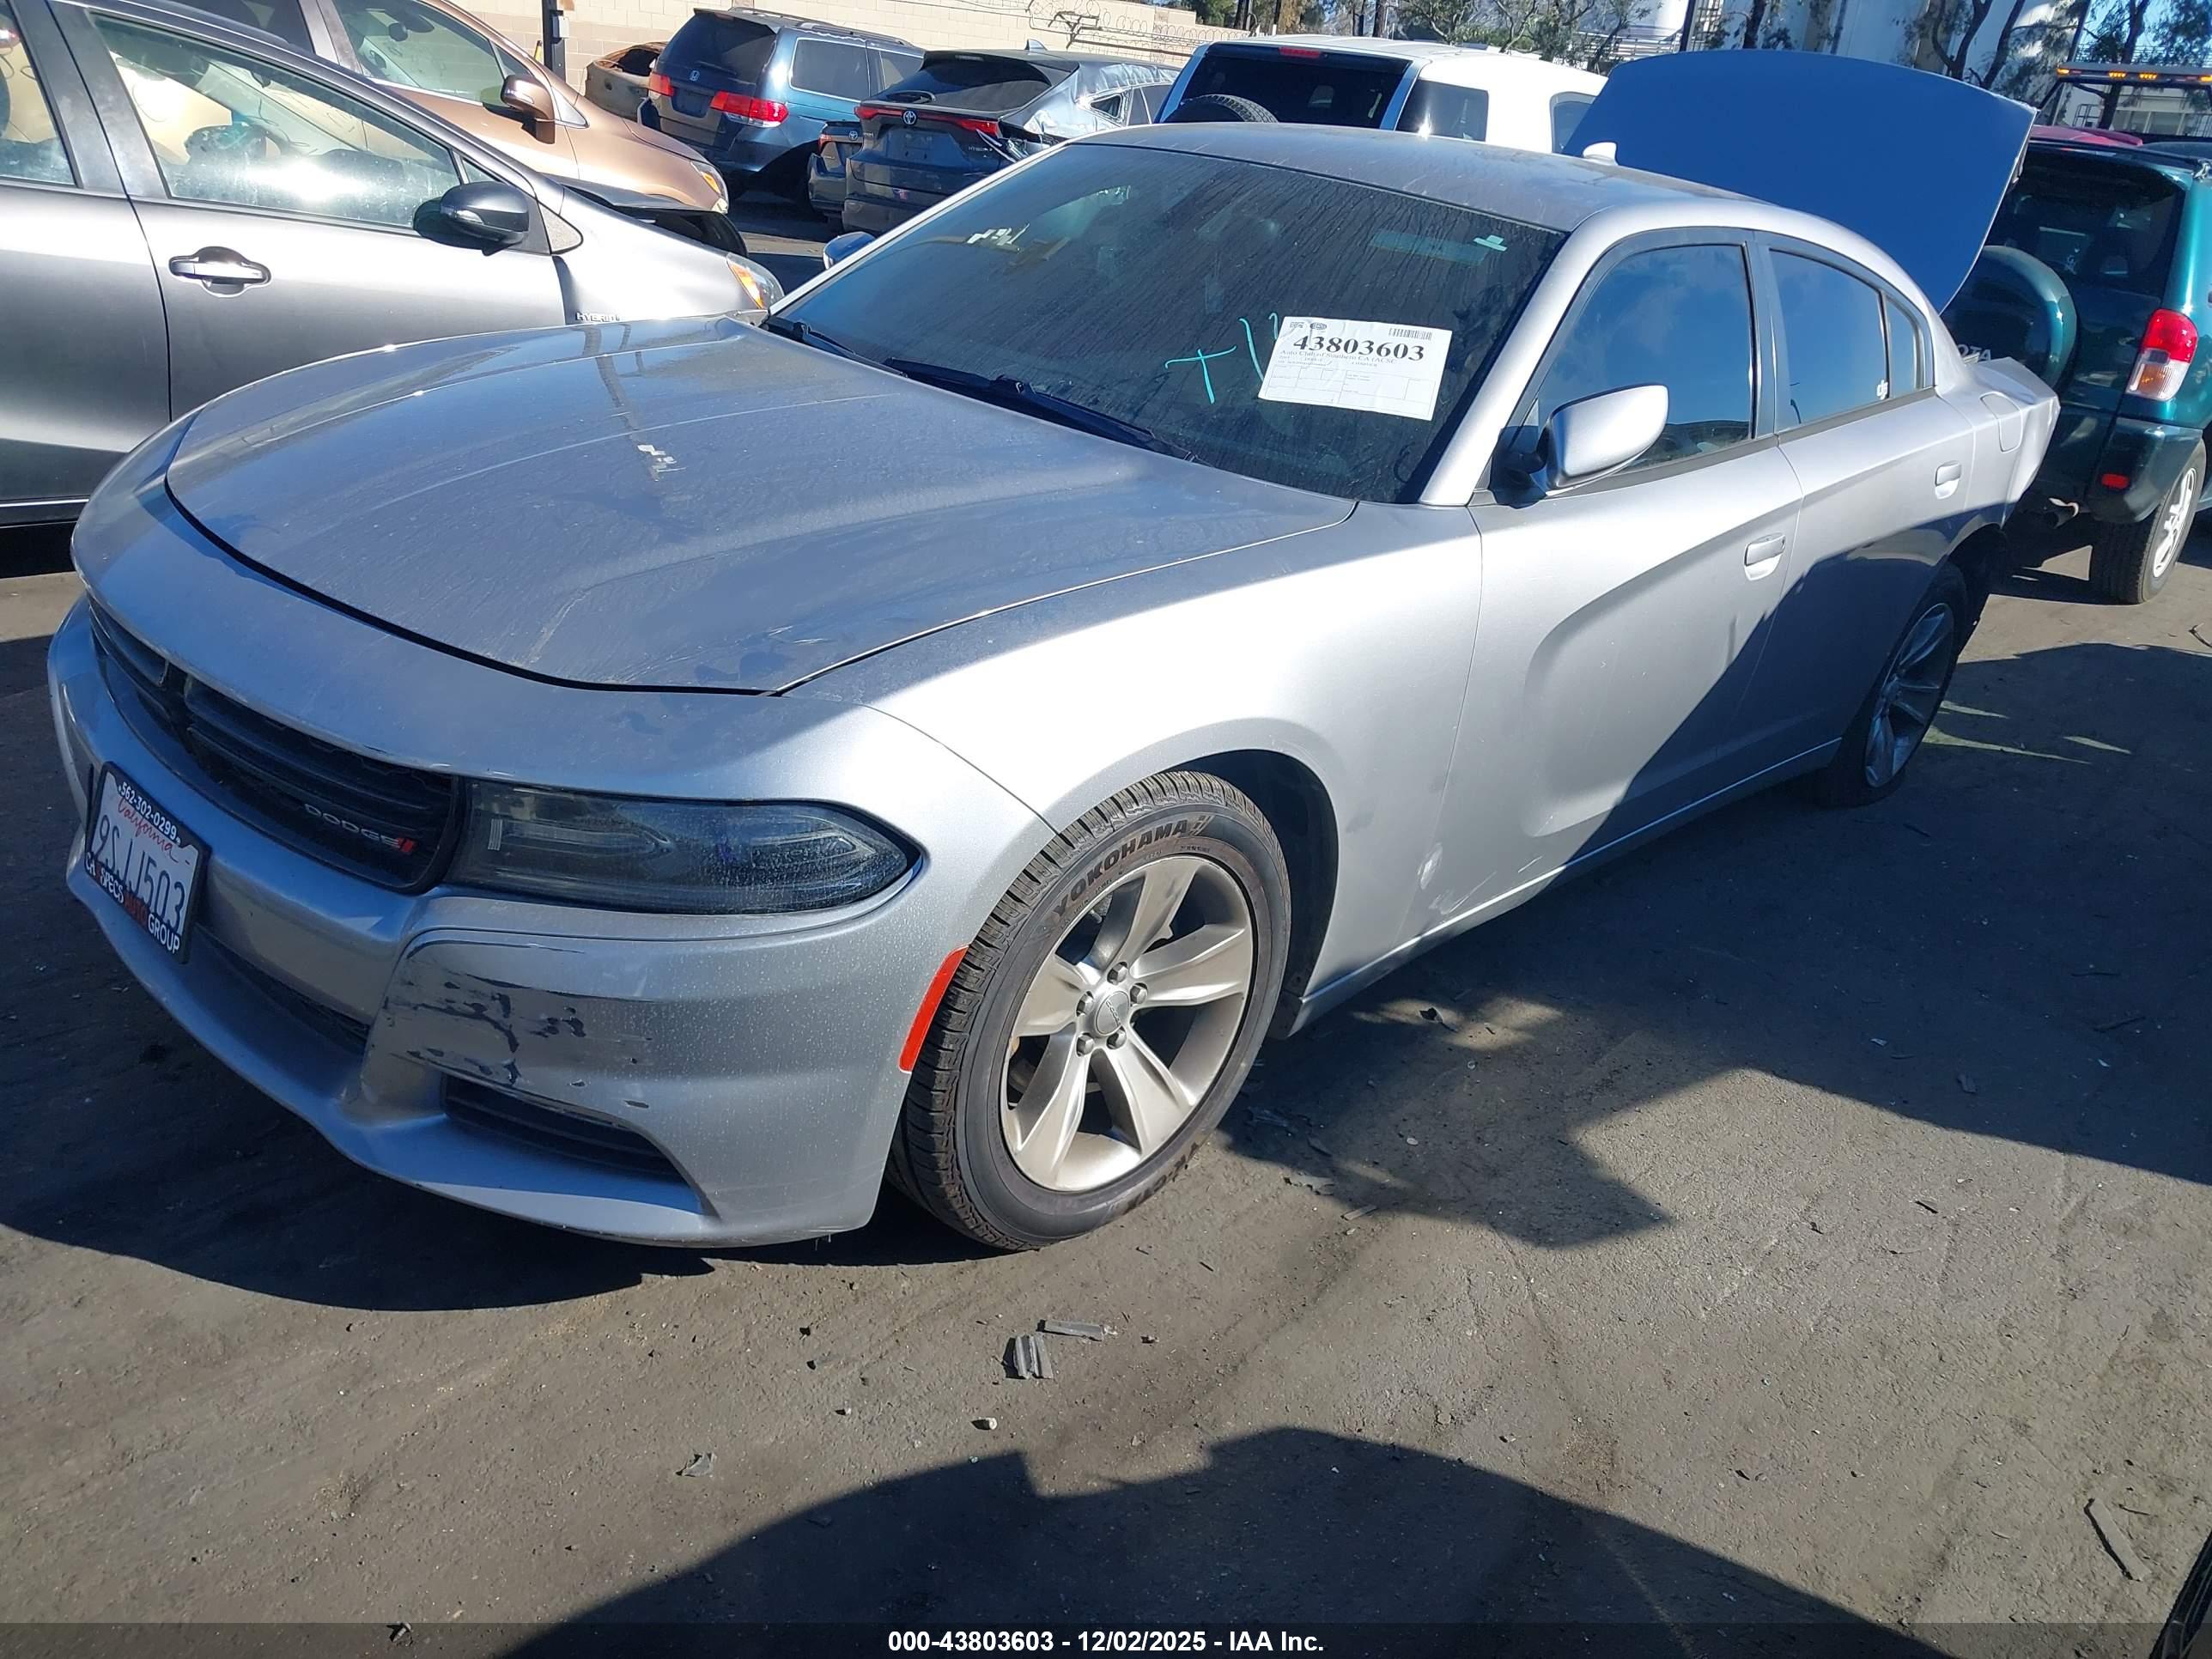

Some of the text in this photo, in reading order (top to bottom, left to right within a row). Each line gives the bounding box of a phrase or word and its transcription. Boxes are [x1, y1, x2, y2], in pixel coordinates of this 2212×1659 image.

[1293, 335, 1425, 362] 43803603
[304, 803, 400, 849] DODGE
[1053, 819, 1188, 916] YOKOHAMA
[100, 866, 125, 904] SPECS
[148, 913, 180, 954] GROUP
